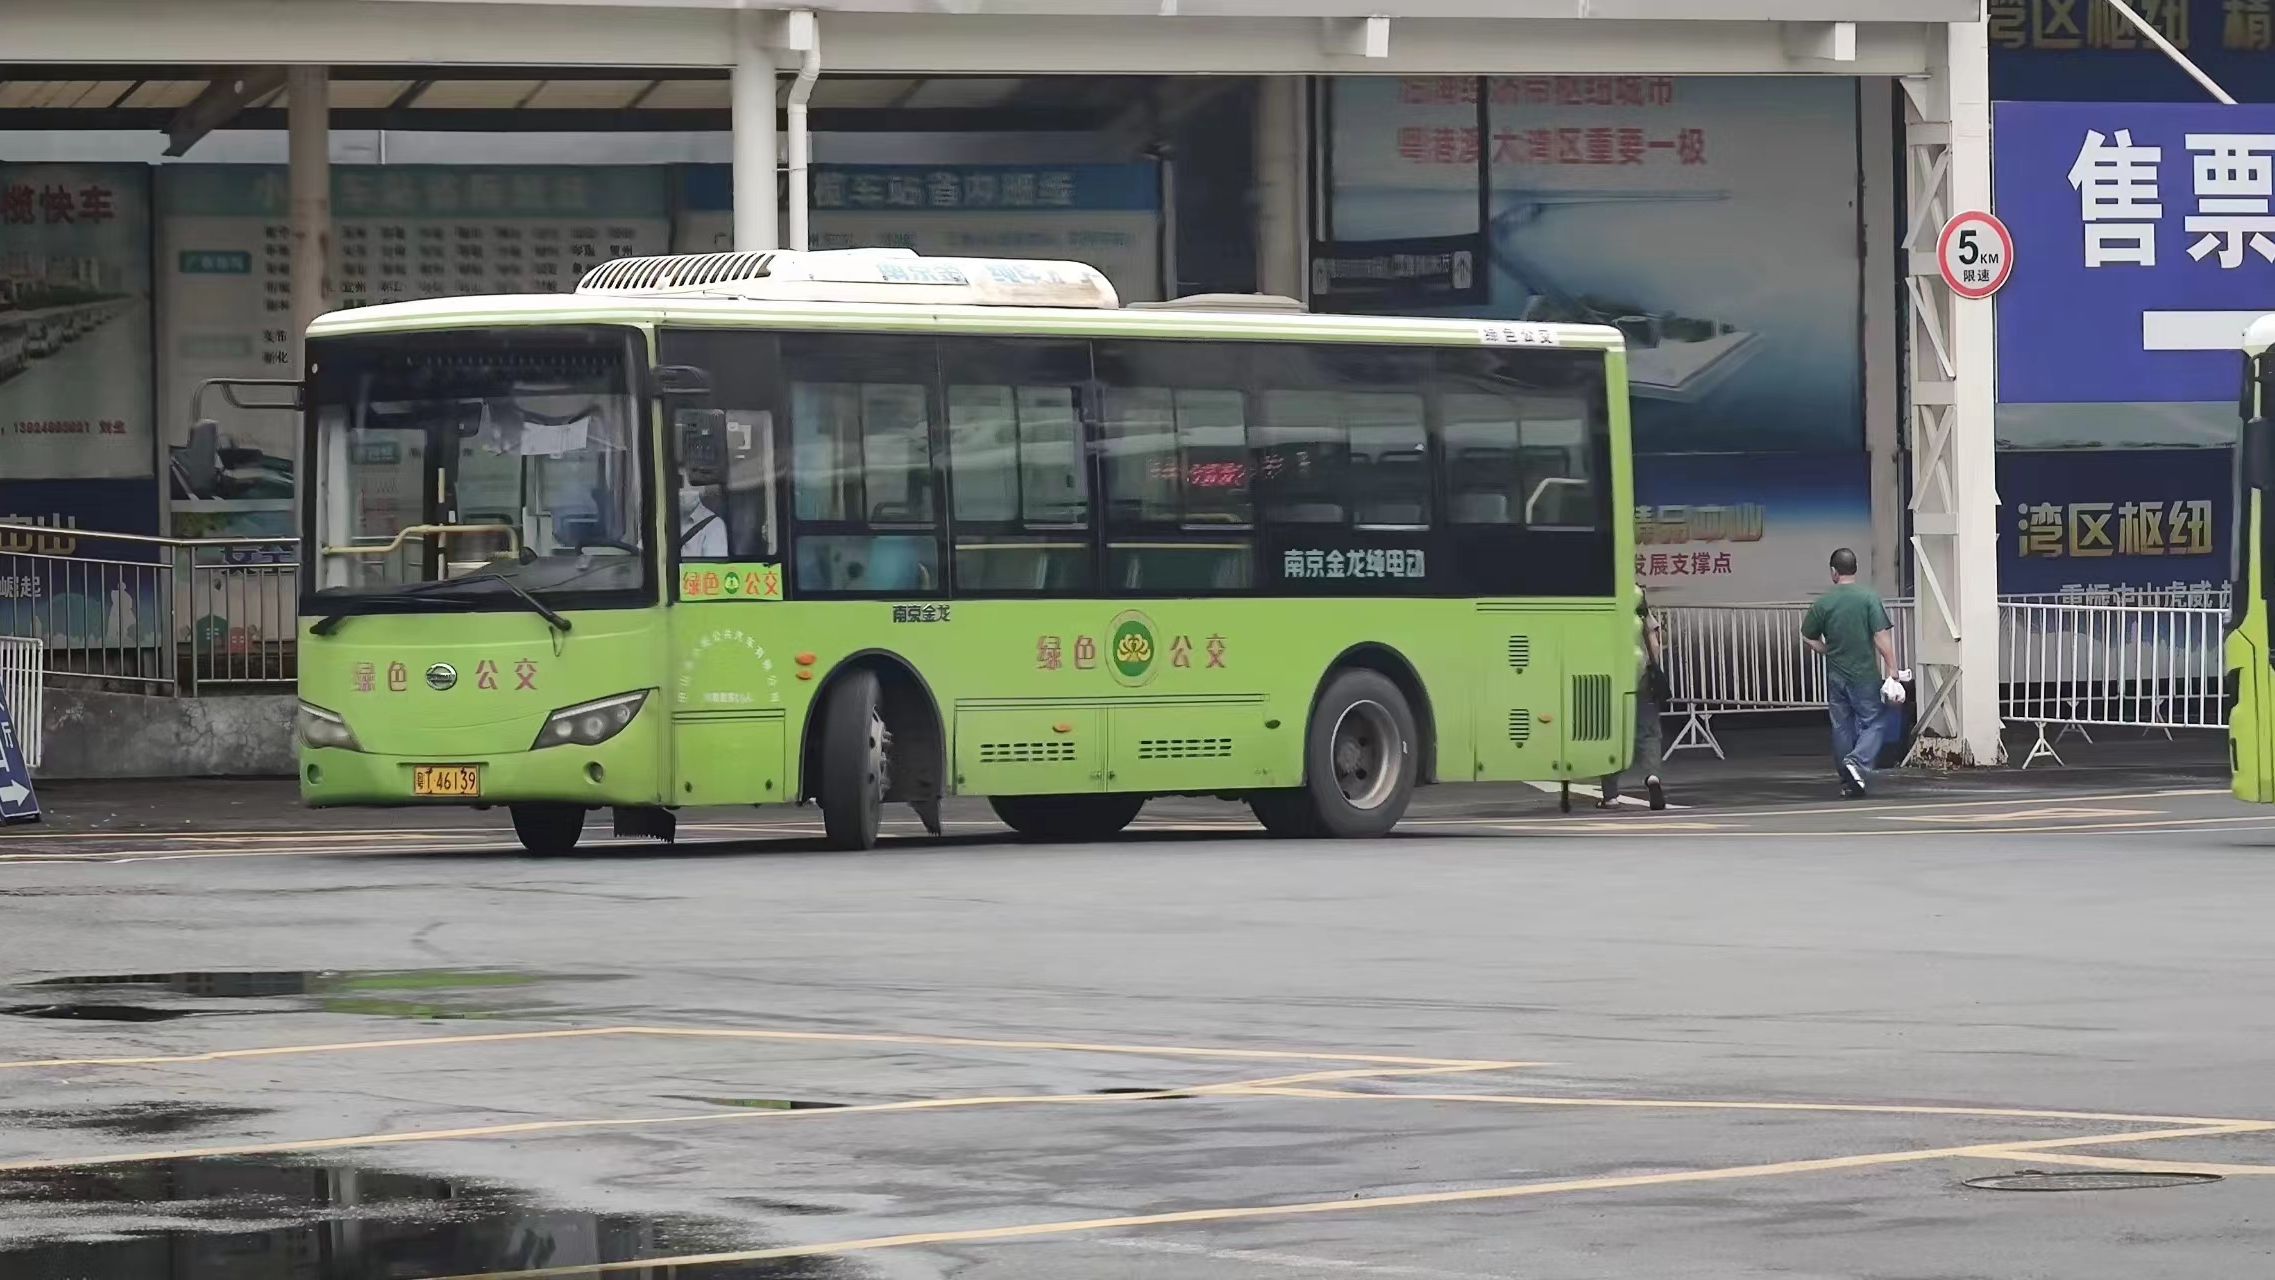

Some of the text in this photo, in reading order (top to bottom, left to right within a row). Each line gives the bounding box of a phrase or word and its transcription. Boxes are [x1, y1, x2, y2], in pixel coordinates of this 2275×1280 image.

[1398, 127, 1706, 164] 粤港澳大湾区重要一极
[2067, 128, 2275, 269] 售票
[1963, 269, 1990, 282] 限速
[2018, 500, 2213, 557] 湾区枢纽
[1284, 548, 1426, 578] 南京金龙纯电动
[1635, 551, 1732, 576] 发展支撑点
[892, 604, 951, 623] 南京金龙
[1036, 633, 1227, 671] 绿色 公交
[475, 657, 541, 691] 公交
